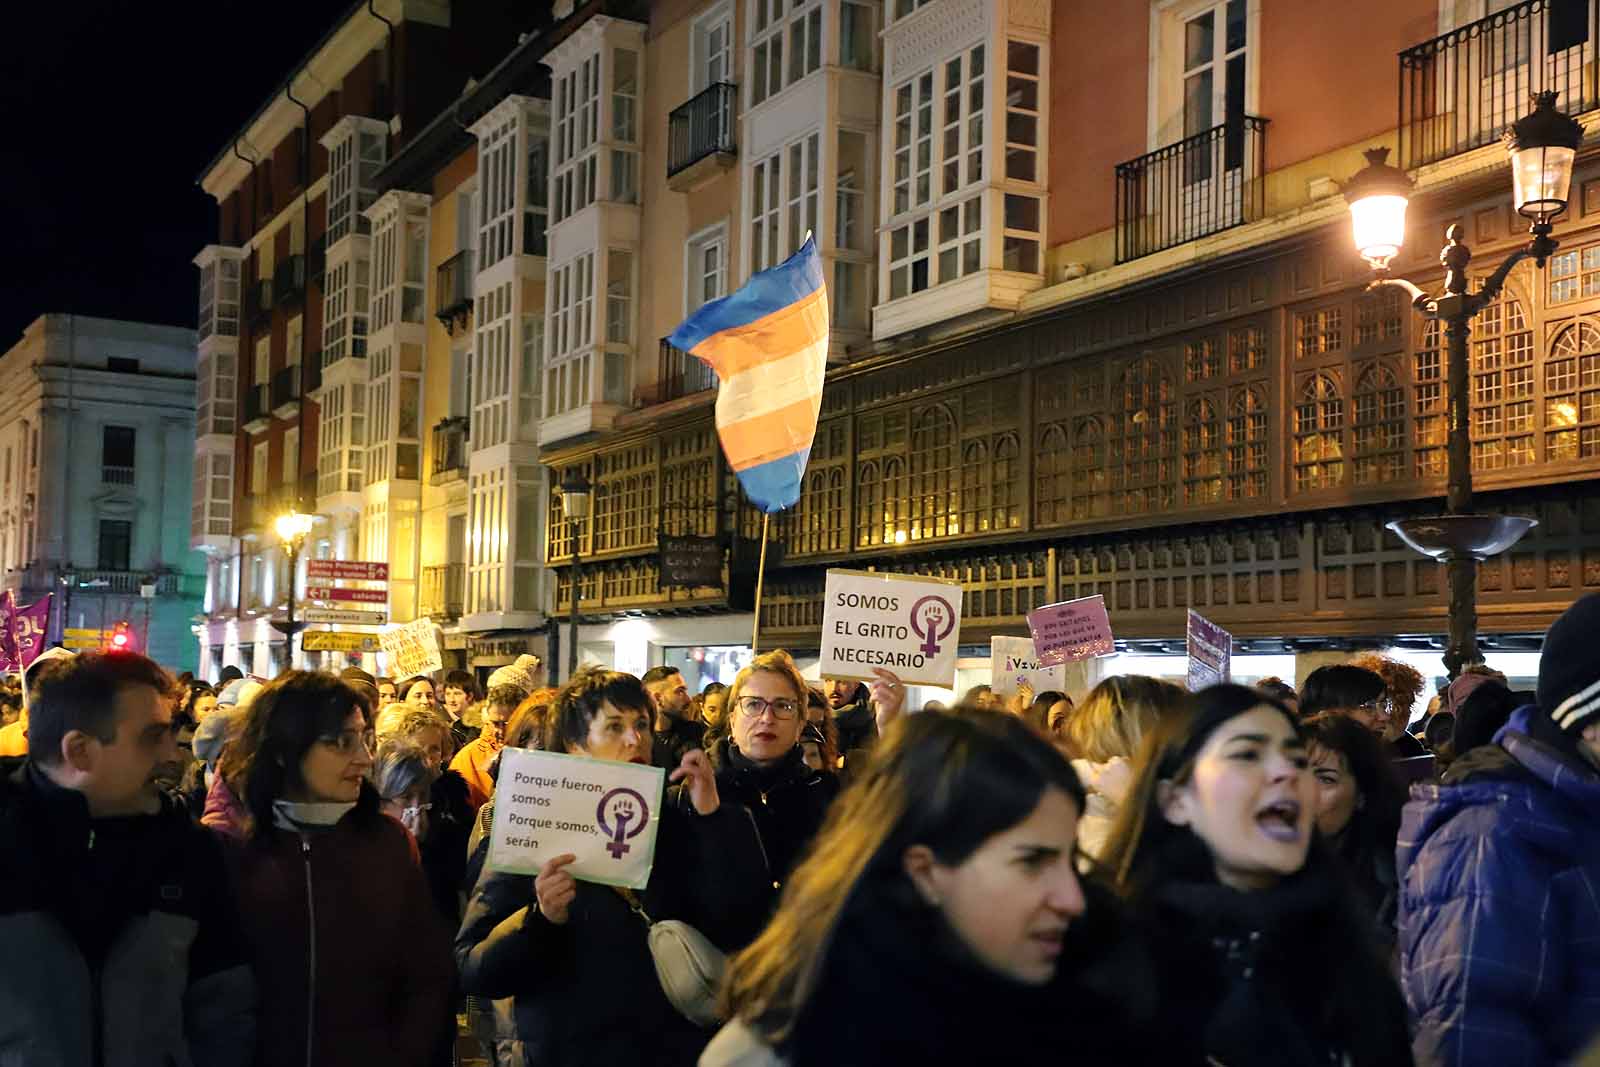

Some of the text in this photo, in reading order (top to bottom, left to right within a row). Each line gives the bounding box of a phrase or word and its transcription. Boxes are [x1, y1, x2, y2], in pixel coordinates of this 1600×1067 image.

[836, 592, 899, 612] SOMOS
[835, 621, 909, 640] EL GRITO
[832, 646, 925, 669] NECESARIO
[514, 771, 606, 794] Porque fueron,
[511, 792, 551, 807] somos
[509, 813, 599, 836] Porque somos,
[505, 834, 539, 849] serán
